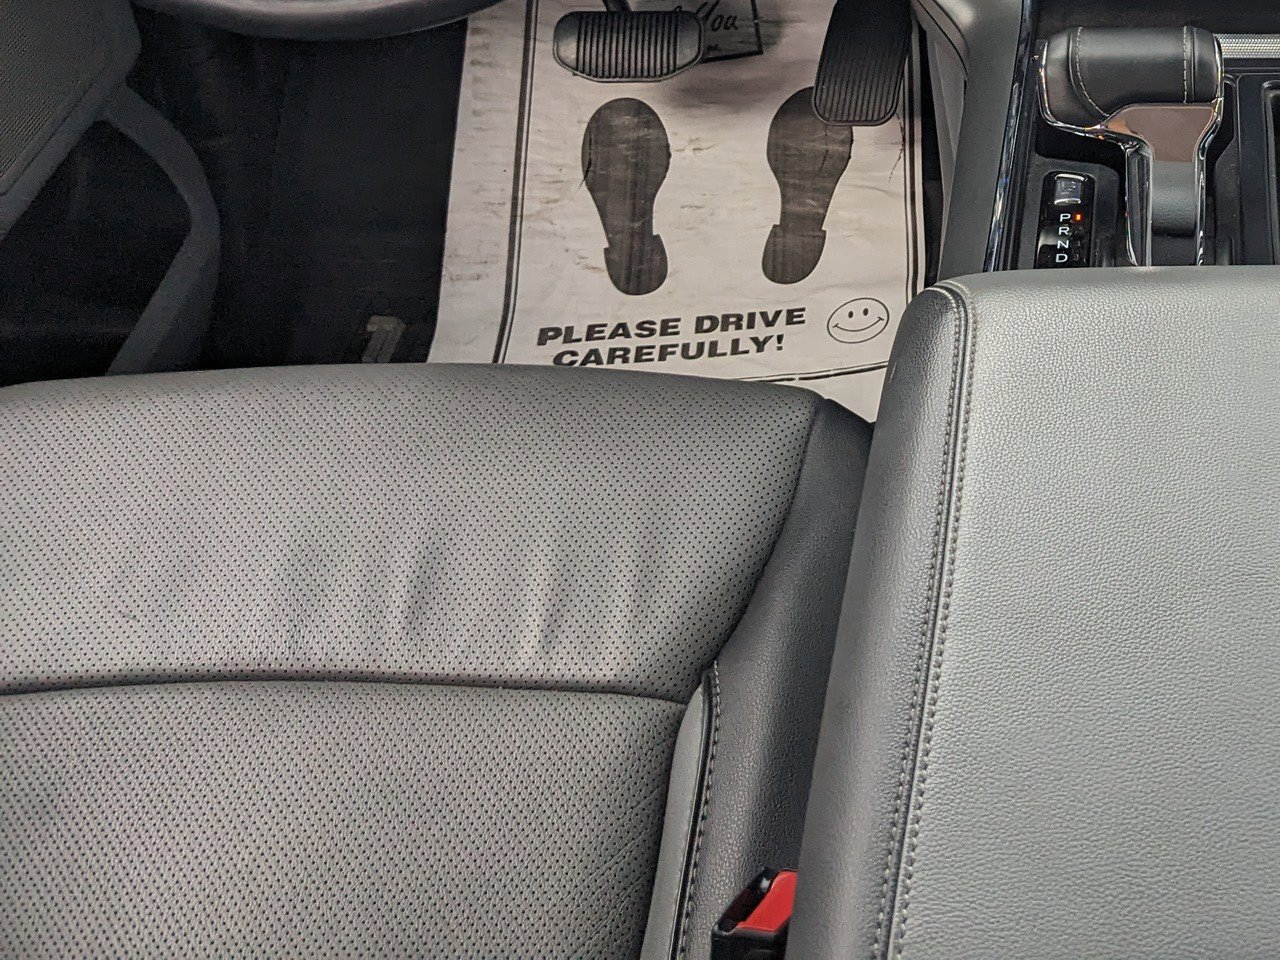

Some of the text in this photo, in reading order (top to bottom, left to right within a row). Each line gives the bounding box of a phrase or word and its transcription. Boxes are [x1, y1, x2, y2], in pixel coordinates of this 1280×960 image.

[1060, 213, 1071, 222] P
[1058, 226, 1070, 235] R
[1056, 240, 1069, 249] N
[1055, 253, 1068, 263] D
[537, 307, 806, 346] PLEASE DRIVE
[552, 334, 785, 367] CAREFULLY!
